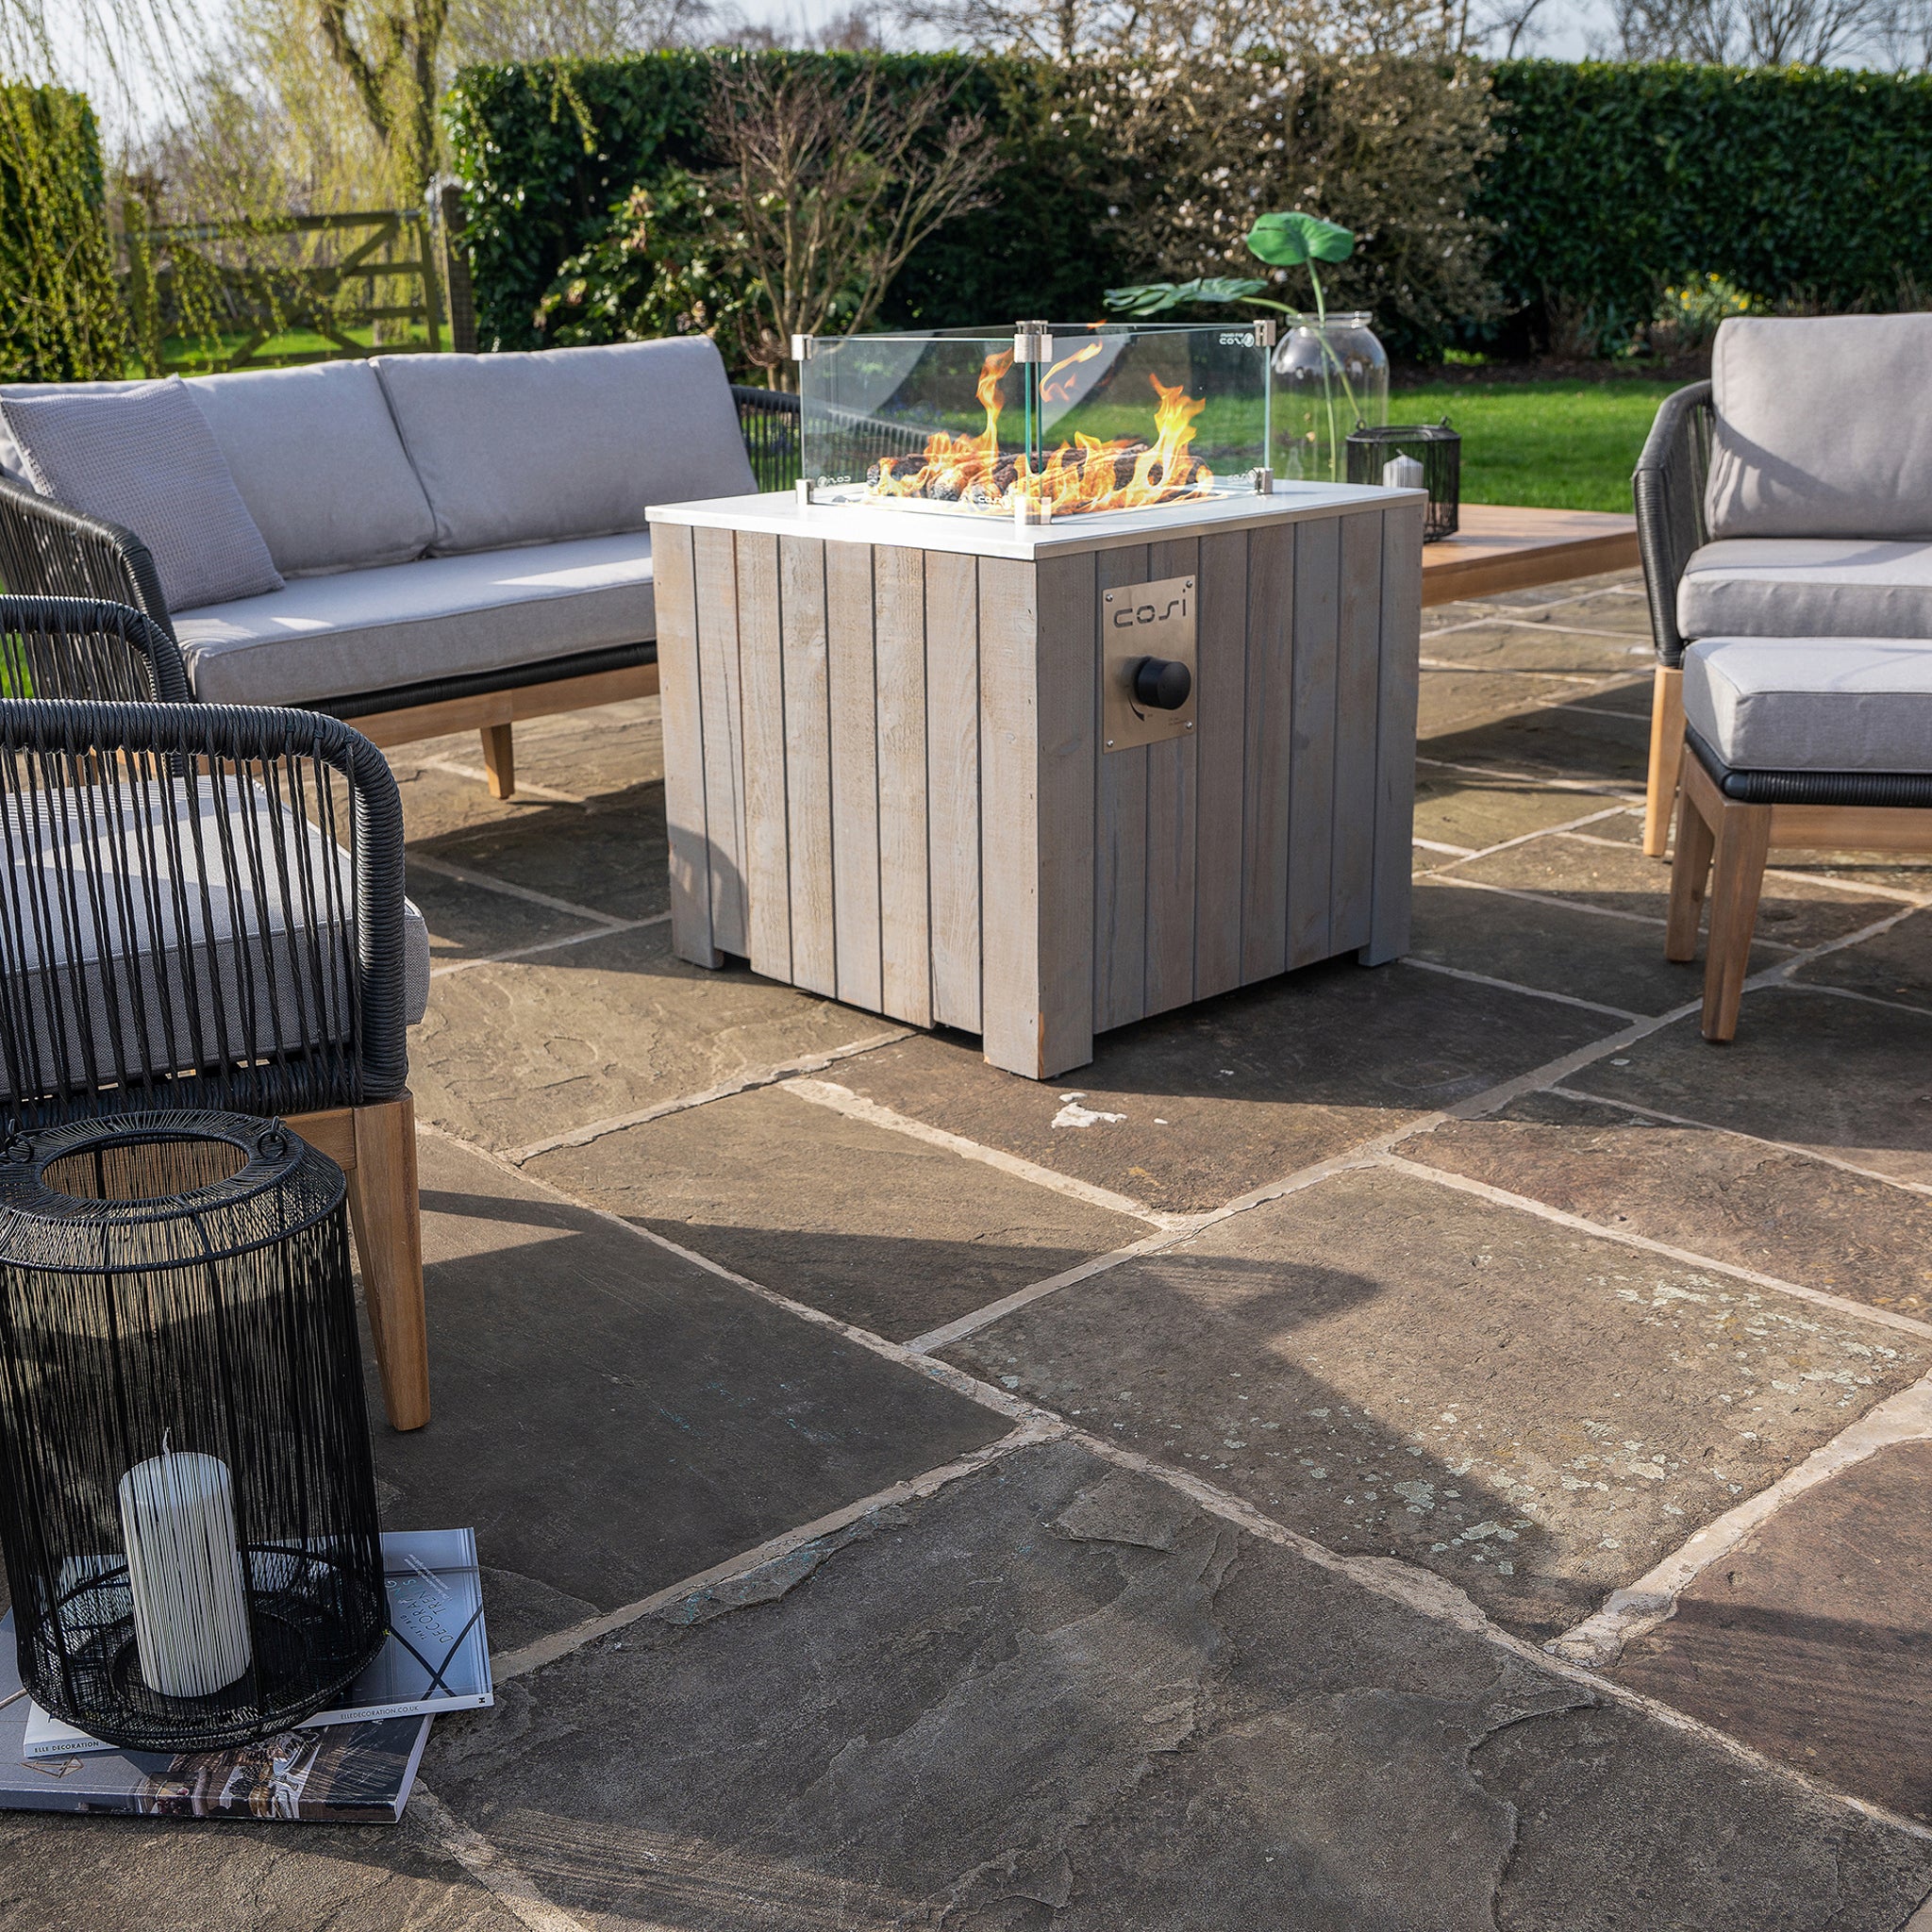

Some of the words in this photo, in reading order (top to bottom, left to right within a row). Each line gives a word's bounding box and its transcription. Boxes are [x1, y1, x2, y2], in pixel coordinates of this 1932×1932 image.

[1113, 588, 1187, 628] cosi
[341, 1706, 420, 1721] ELLEDECORATION.CO.UK
[52, 1741, 100, 1753] DECORATION
